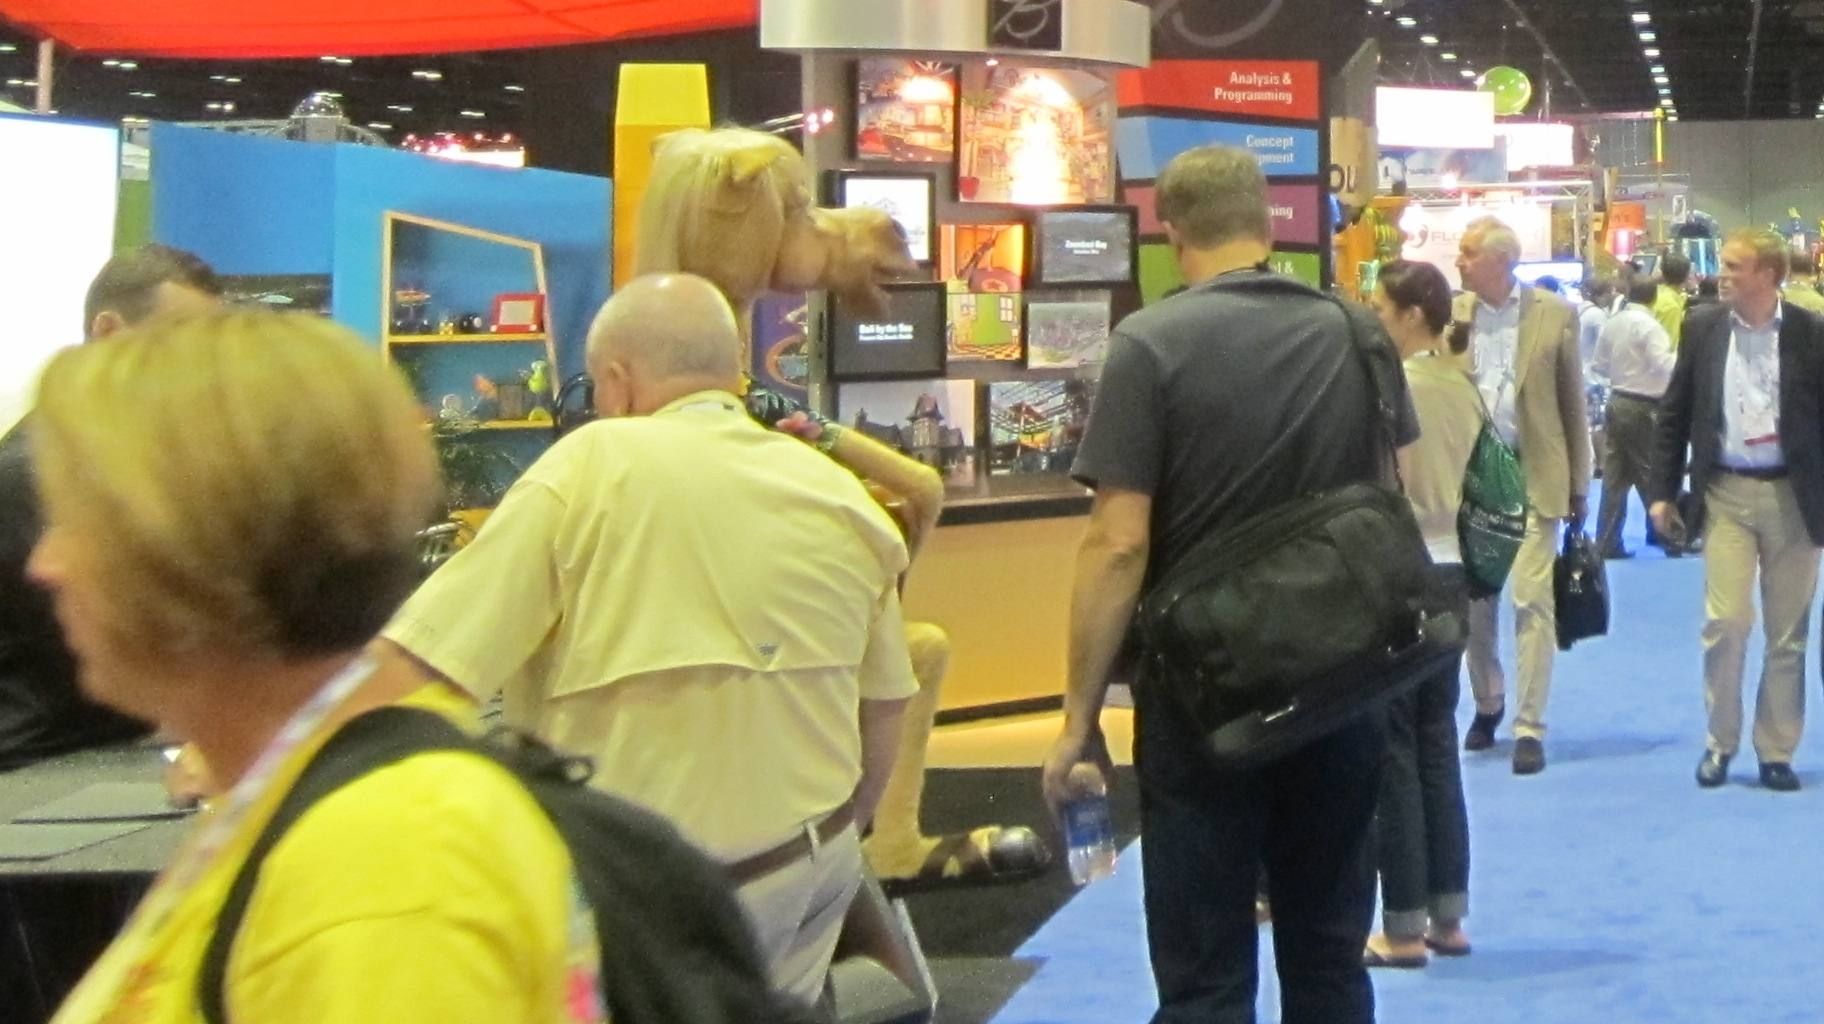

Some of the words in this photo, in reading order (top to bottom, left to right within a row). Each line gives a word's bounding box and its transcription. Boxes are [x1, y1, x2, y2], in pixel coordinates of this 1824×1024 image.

[1230, 71, 1279, 88] Analysis
[1282, 72, 1293, 86] &
[1214, 87, 1293, 105] Programming
[1246, 135, 1295, 150] Concept
